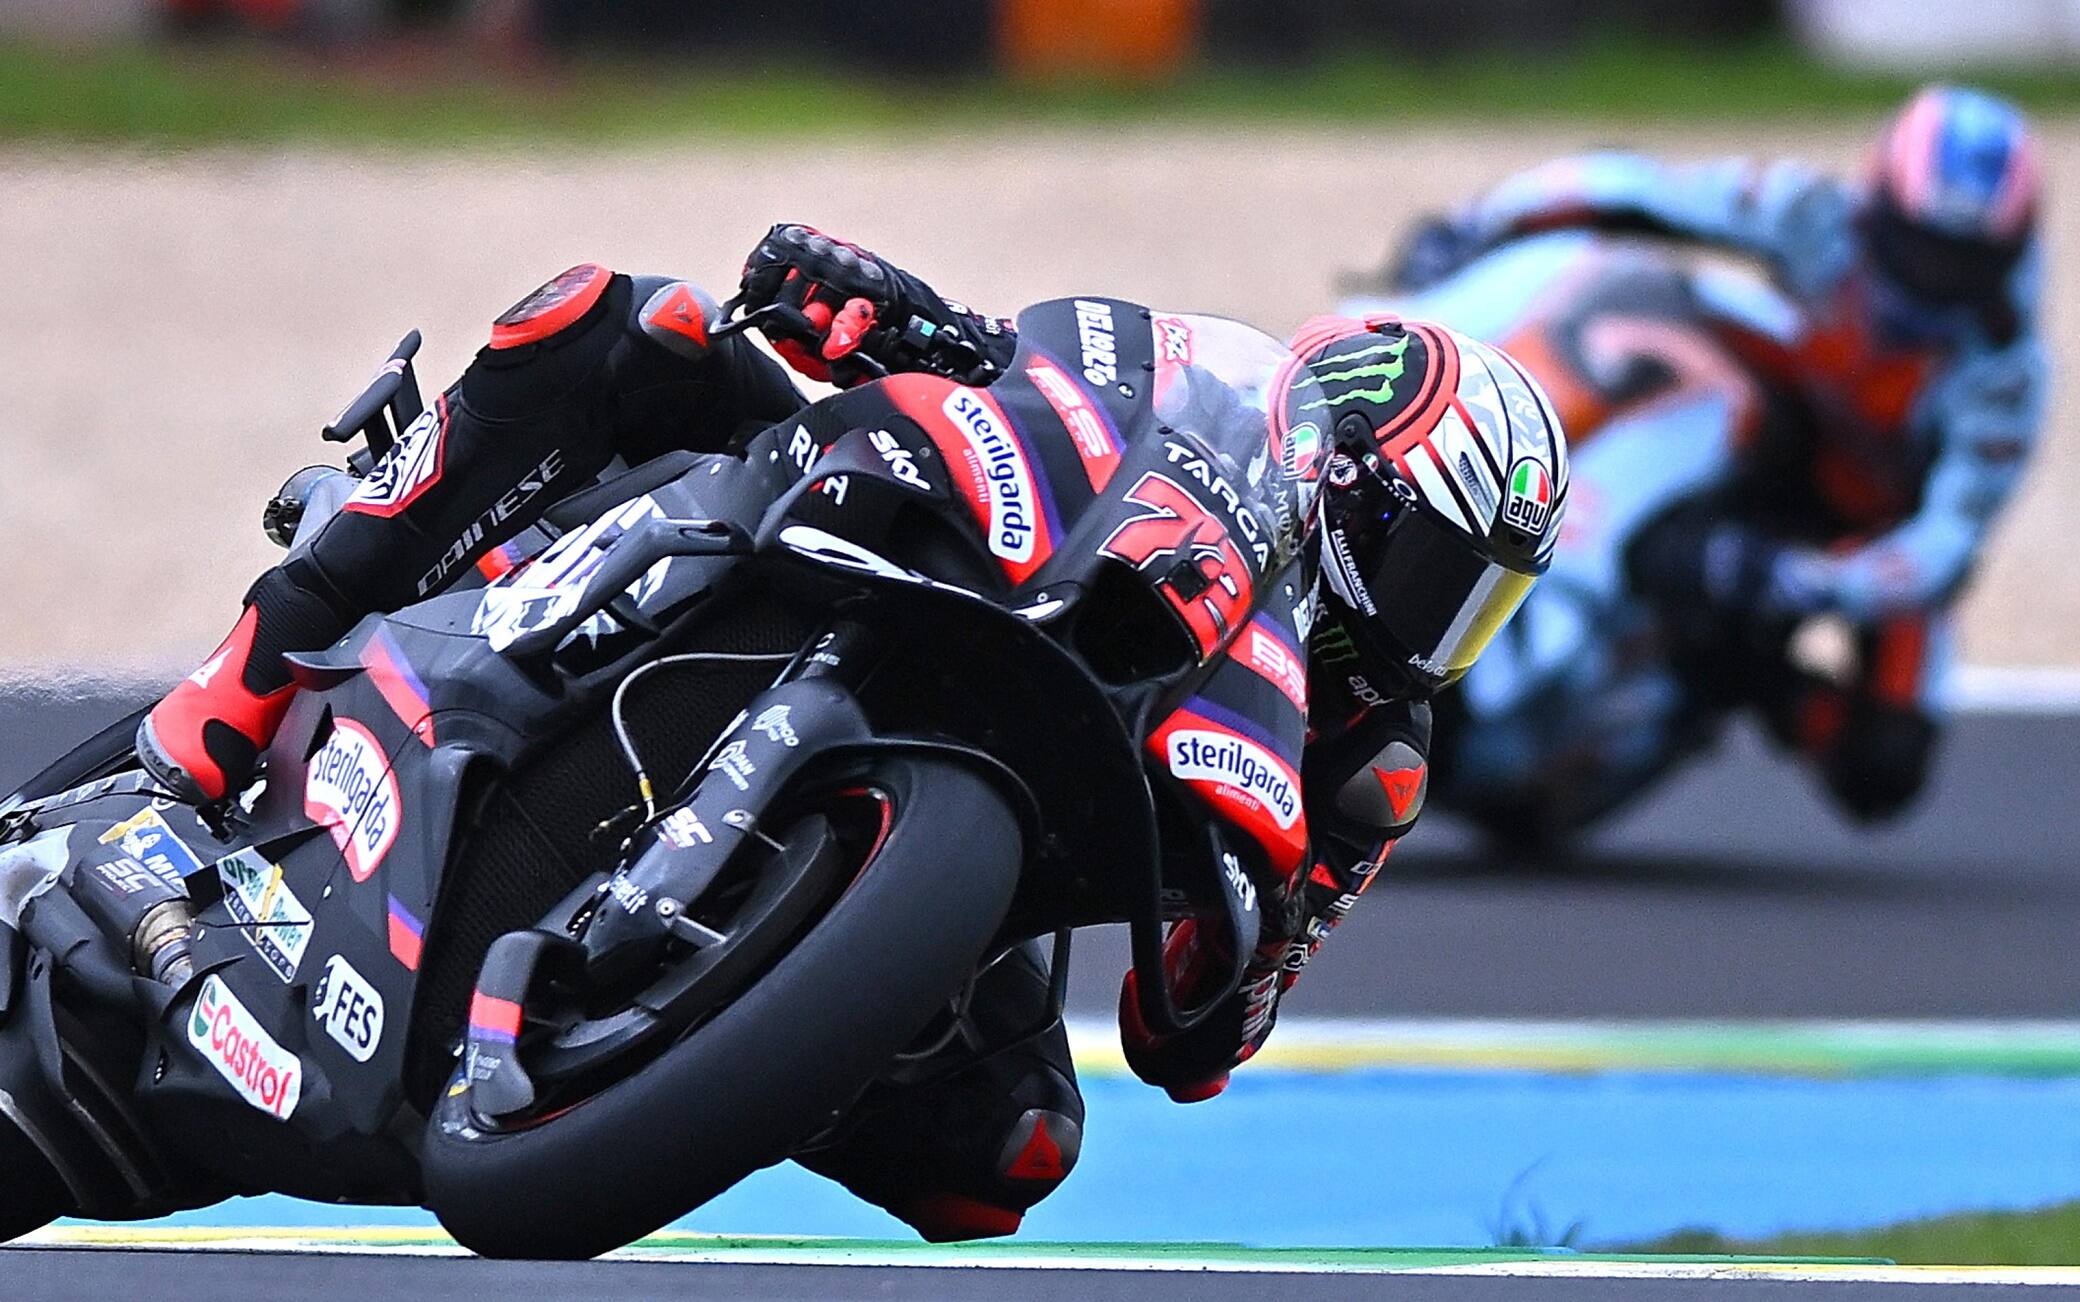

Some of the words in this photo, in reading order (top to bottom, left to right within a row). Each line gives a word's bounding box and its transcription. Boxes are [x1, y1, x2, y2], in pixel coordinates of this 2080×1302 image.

[1025, 366, 1111, 457] BS
[954, 396, 1032, 551] sterilgarda
[962, 448, 990, 503] alimenti
[1164, 441, 1270, 573] TARGA
[313, 740, 390, 852] sterilgada
[1176, 737, 1295, 817] sterilgarda
[1215, 783, 1261, 812] alimenti
[212, 1004, 293, 1116] Castrol
